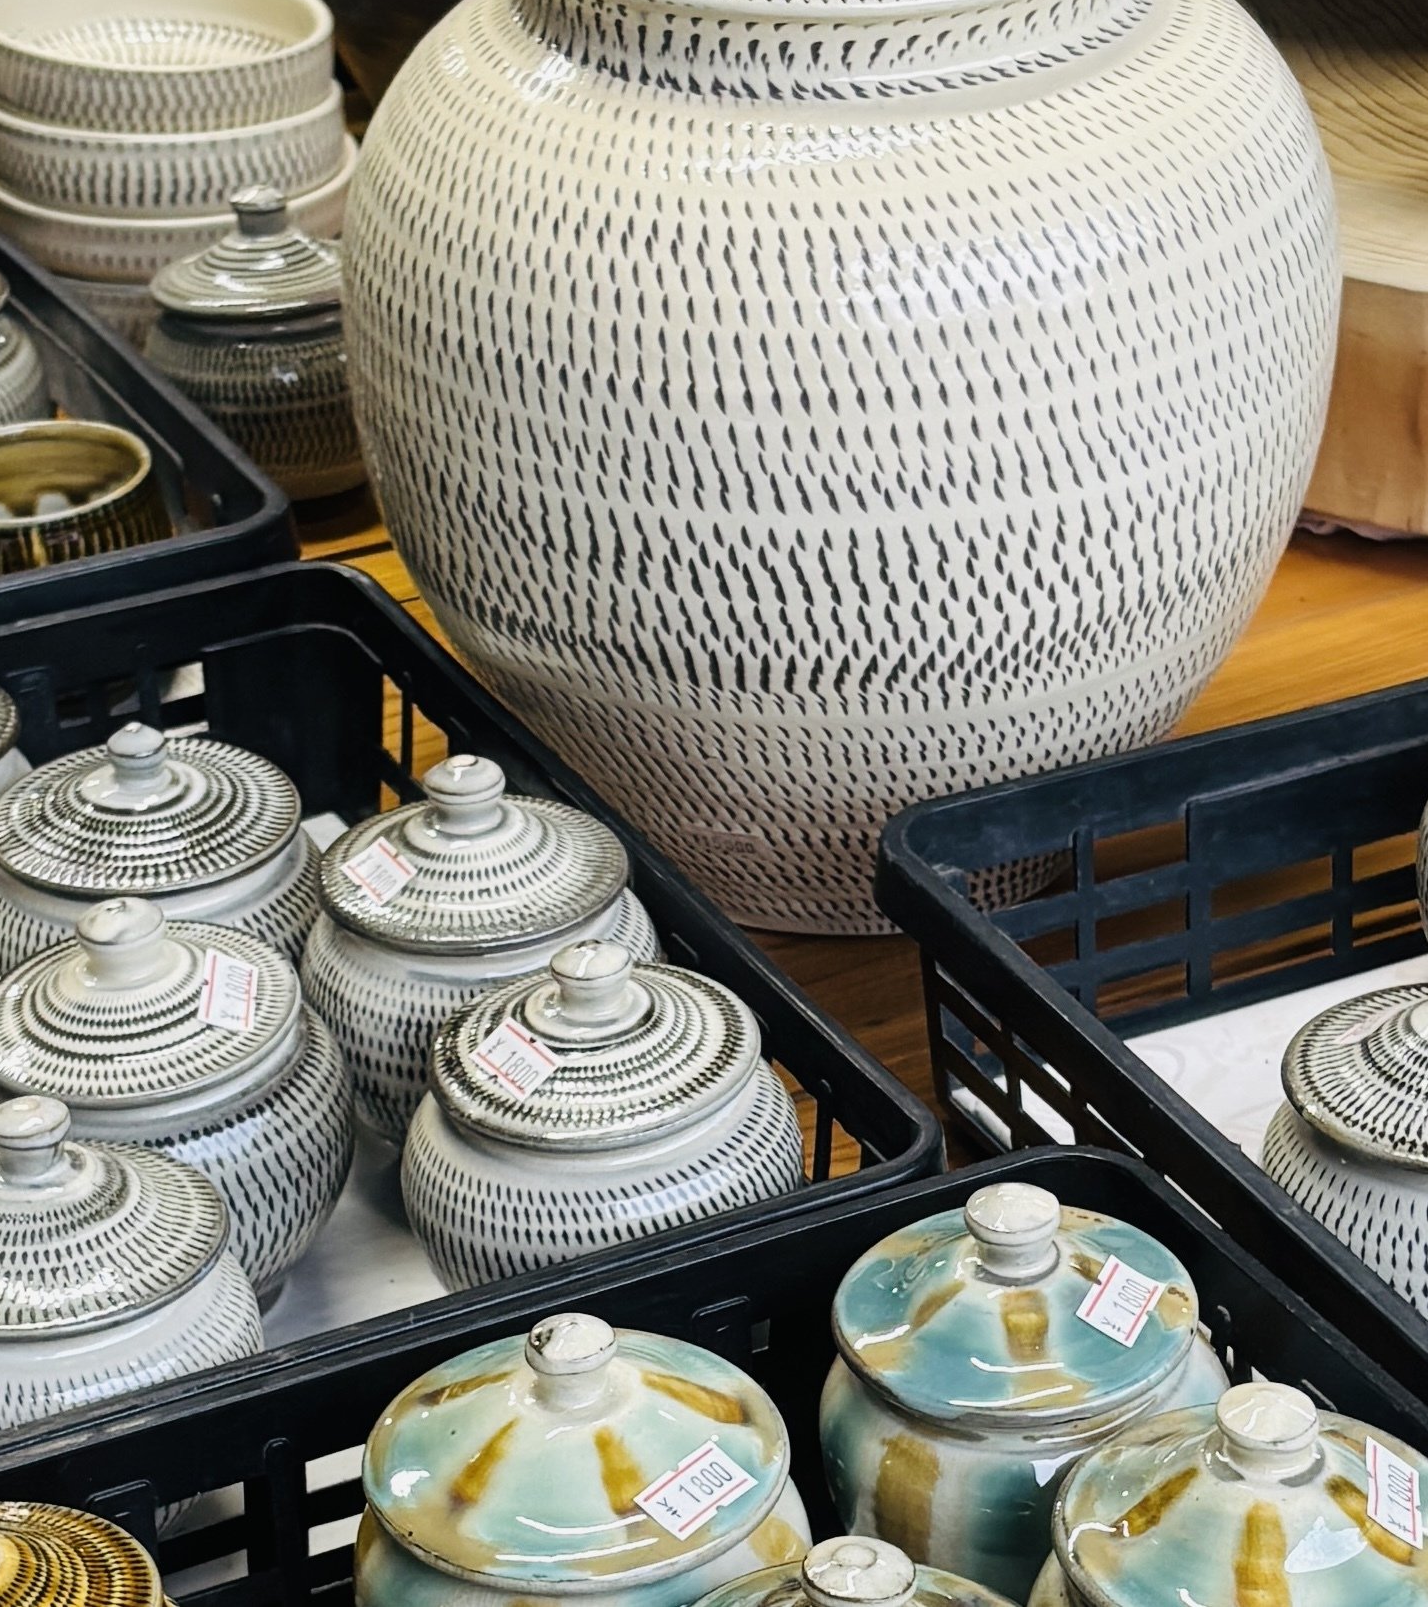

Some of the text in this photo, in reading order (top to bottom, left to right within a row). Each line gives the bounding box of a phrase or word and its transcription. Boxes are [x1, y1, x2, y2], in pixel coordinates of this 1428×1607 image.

[220, 965, 252, 1021] ¥1800
[485, 1037, 540, 1092] ¥1800
[1101, 1278, 1151, 1336] ¥1800
[656, 1461, 734, 1519] ¥1800
[1388, 1464, 1414, 1534] ¥1800
